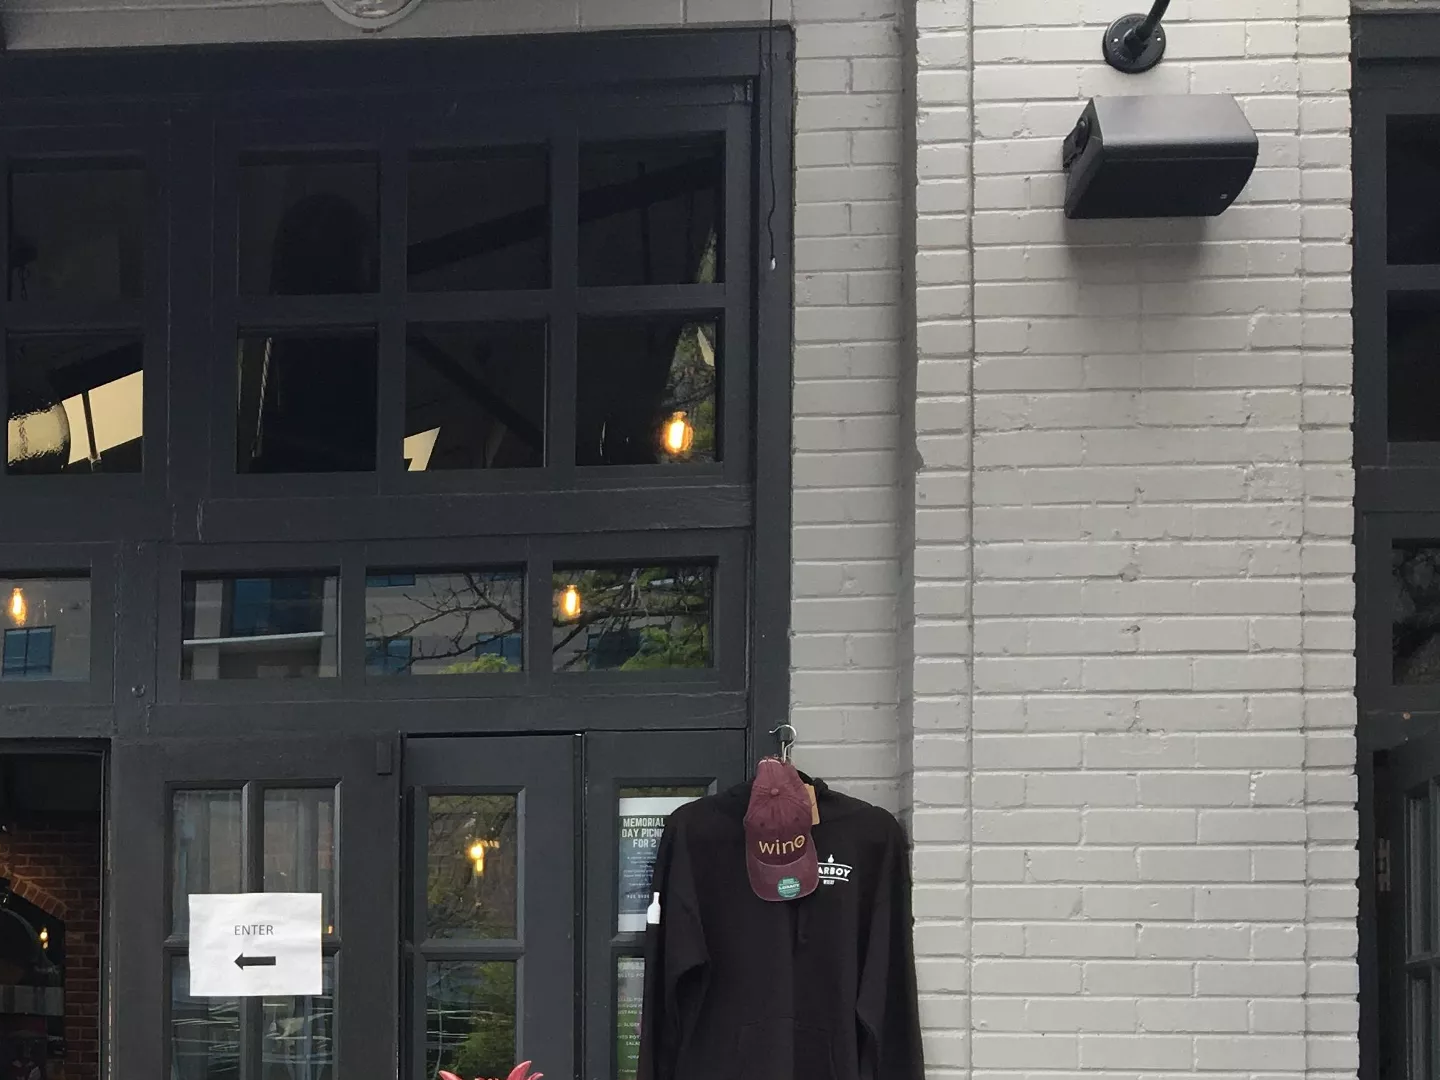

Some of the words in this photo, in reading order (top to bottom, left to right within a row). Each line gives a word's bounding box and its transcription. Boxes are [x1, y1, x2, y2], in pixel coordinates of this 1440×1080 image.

[623, 817, 665, 827] MEMORIAL
[622, 828, 639, 838] DAY
[633, 839, 649, 848] FOR
[650, 839, 657, 848] 2
[759, 835, 806, 855] wino
[818, 866, 851, 878] ARBOY
[234, 924, 274, 936] ENTER
